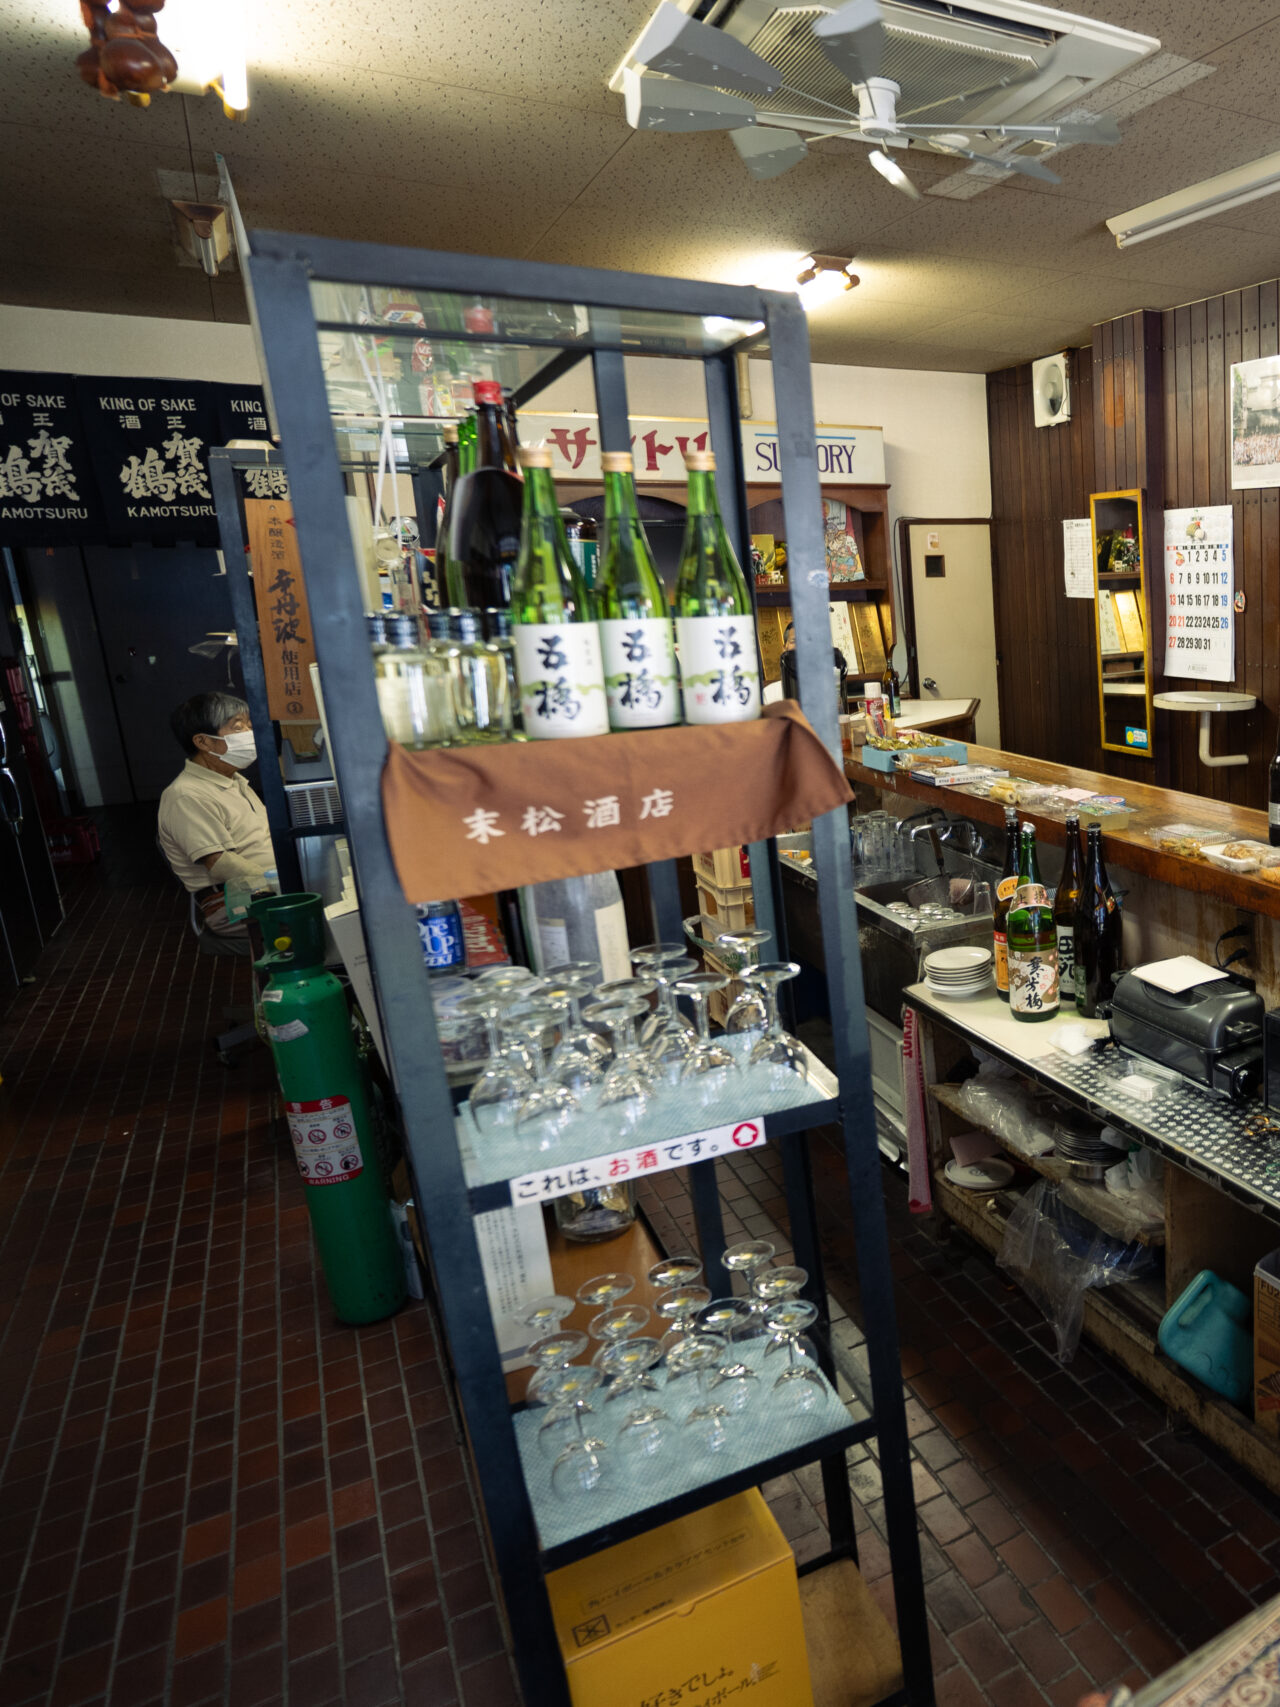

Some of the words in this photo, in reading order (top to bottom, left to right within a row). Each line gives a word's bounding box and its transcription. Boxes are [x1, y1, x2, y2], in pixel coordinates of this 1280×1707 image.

[27, 395, 67, 409] SAKE
[99, 397, 135, 411] KING
[138, 399, 156, 411] OF
[161, 398, 197, 412] SAKE
[230, 400, 262, 413] KING
[0, 507, 89, 519] AMOTSURU
[1188, 551, 1191, 562] 1
[1196, 551, 1200, 562] 2
[1204, 551, 1208, 562] 3
[1213, 551, 1217, 562] 4
[1222, 550, 1226, 562] 5
[1170, 573, 1174, 584] 6
[1179, 573, 1182, 584] 7
[1188, 573, 1191, 584] 8
[1196, 573, 1199, 584] 9
[1203, 572, 1210, 584] 10
[1212, 572, 1218, 584] 11
[1221, 572, 1227, 584] 12
[1170, 594, 1176, 605] 13
[1178, 594, 1184, 606] 14
[1187, 594, 1193, 606] 15
[1195, 594, 1201, 606] 16
[1203, 594, 1210, 606] 17
[1212, 595, 1219, 606] 18
[1221, 595, 1228, 606] 19
[1169, 616, 1176, 627] 20
[1178, 616, 1185, 628] 21
[1186, 616, 1193, 628] 22
[1195, 616, 1202, 628] 23
[1203, 617, 1210, 628] 24
[1212, 617, 1219, 628] 25
[1221, 617, 1228, 629] 26
[1169, 637, 1176, 648] 27
[1177, 637, 1185, 648] 28
[1186, 637, 1193, 649] 29
[1195, 638, 1202, 649] 30
[1204, 638, 1210, 650] 31
[281, 650, 302, 697] 使用店
[462, 789, 675, 845] 末松酒店
[423, 955, 453, 965] ZEKI
[308, 1174, 350, 1185] WARNING
